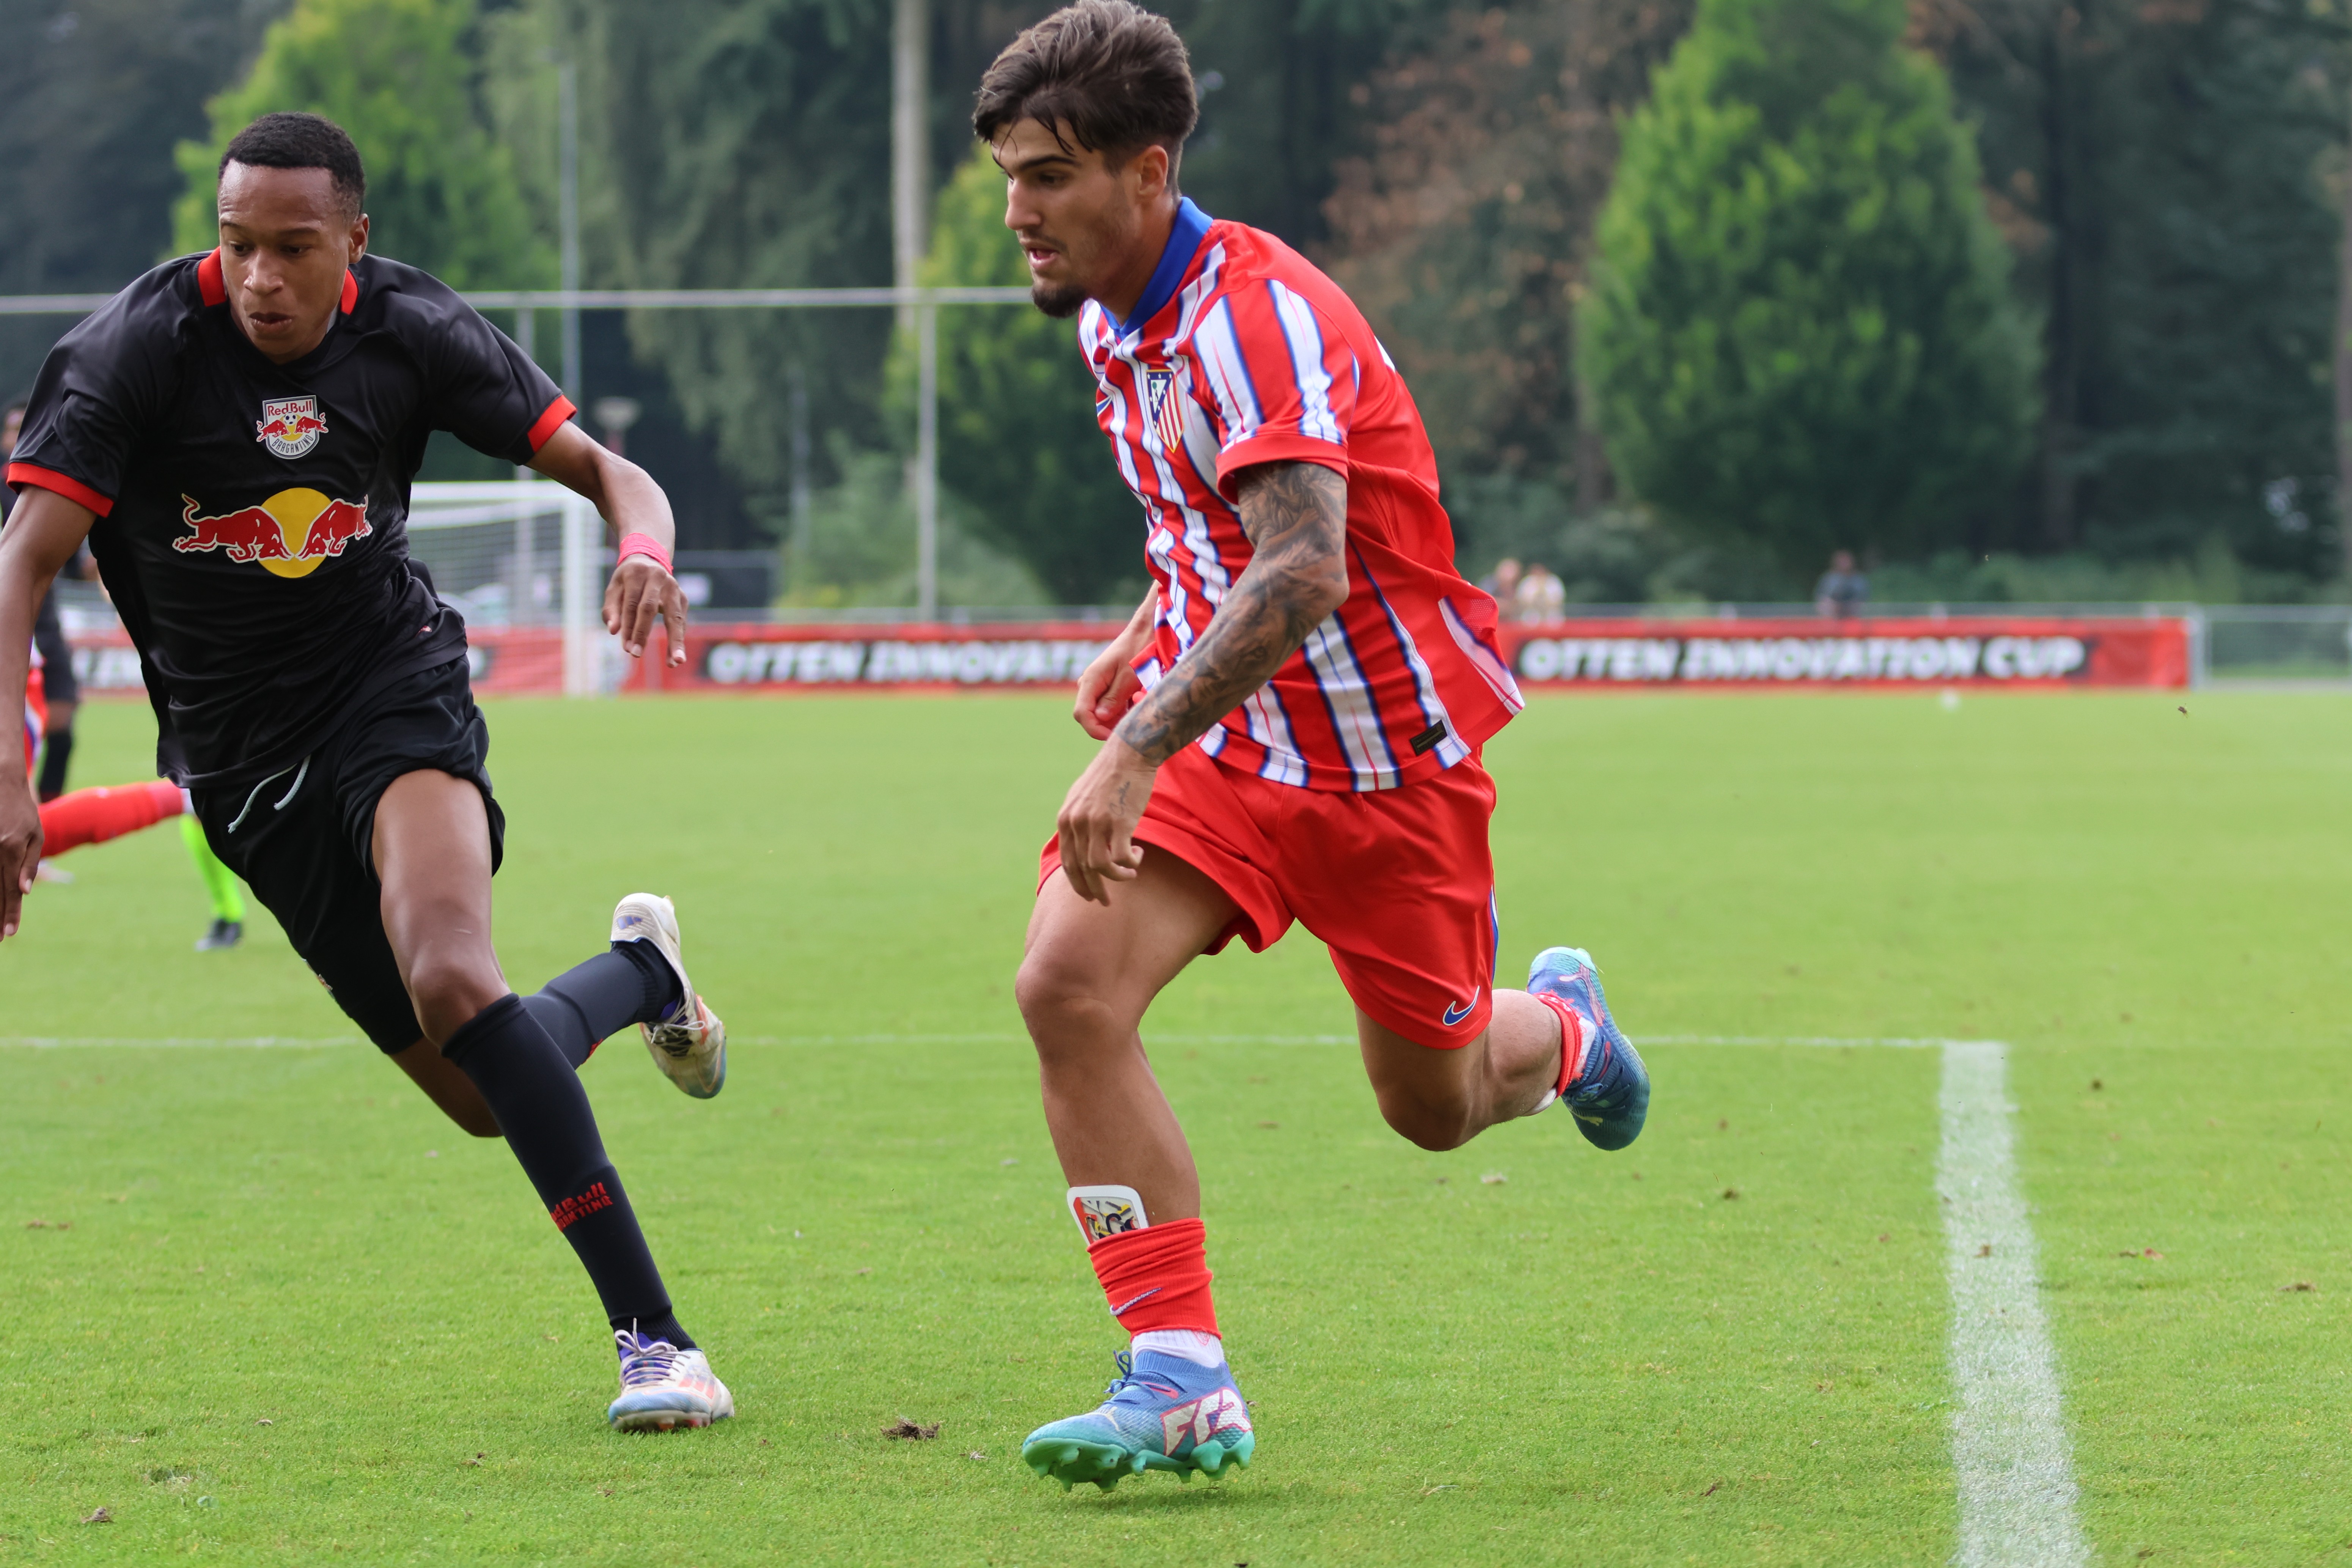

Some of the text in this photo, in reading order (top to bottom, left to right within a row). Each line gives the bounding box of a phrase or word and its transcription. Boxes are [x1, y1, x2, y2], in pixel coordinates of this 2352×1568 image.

[267, 400, 312, 416] Red Bull
[272, 434, 314, 453] BRAGANTINO
[707, 640, 866, 684] OTTEN
[1519, 637, 1680, 681] OTTEN
[1981, 635, 2086, 680] CUP
